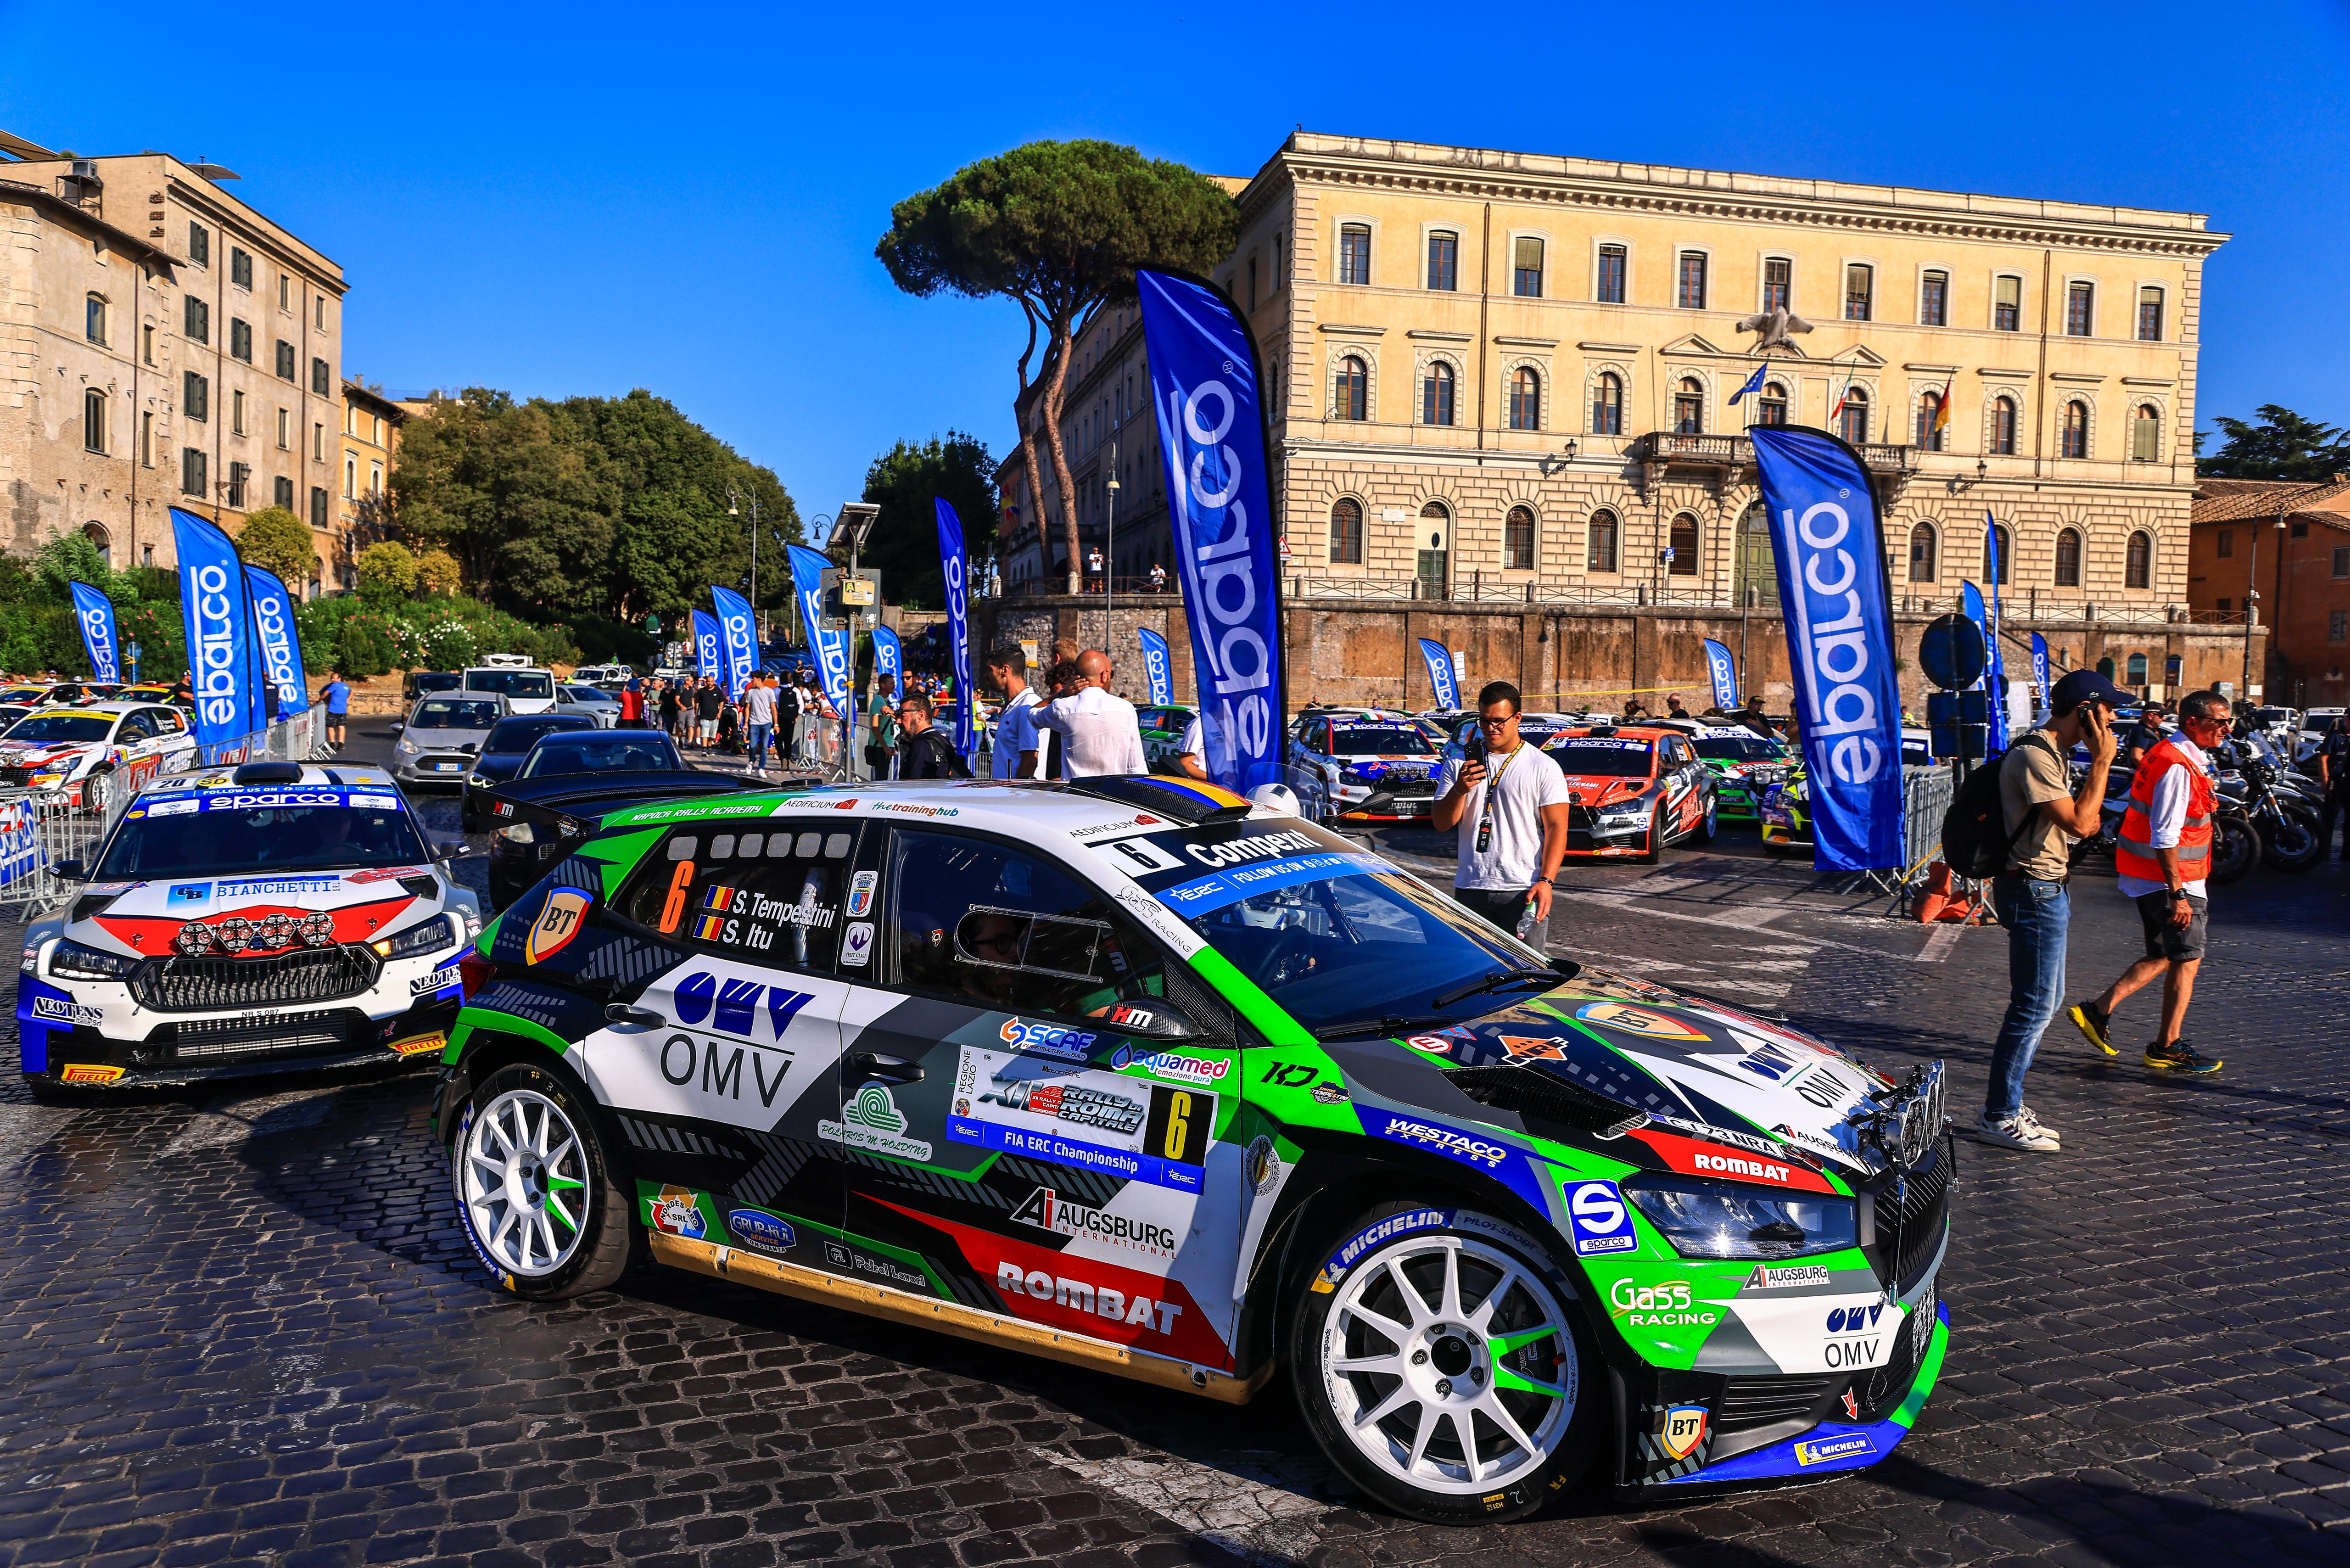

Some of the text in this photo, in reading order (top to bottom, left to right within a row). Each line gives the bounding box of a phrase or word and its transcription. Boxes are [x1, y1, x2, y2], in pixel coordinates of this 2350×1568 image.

[1568, 740, 1622, 749] sparco
[158, 778, 187, 789] 20
[209, 794, 340, 810] sparco
[630, 805, 763, 822] NAPOCA RALLY ACADEMY
[783, 798, 834, 810] AEDIFICIUM
[872, 801, 959, 817] thetraininghub
[1069, 820, 1138, 838] AEDIFICIUM
[1112, 843, 1160, 869] 6
[1185, 829, 1325, 868] Compexit
[1234, 862, 1303, 884] FOLLOW US ON
[216, 882, 333, 897] BIANCHETTI
[660, 861, 694, 934] 6
[543, 906, 577, 935] BT
[733, 890, 837, 929] S. Tempestini
[723, 919, 774, 950] S. Itu
[1153, 918, 1193, 954] RACING
[35, 997, 103, 1019] NEOTENS
[1607, 1010, 1658, 1029] BT
[75, 1017, 102, 1027] Italia Srl
[1109, 1021, 1147, 1030] KEANEMOTORSPORT
[395, 1035, 442, 1053] PIRELLI
[1022, 1043, 1064, 1055] INFRASTRUCTURE
[1024, 1028, 1097, 1052] SCAF
[67, 1068, 118, 1081] PIRELLI
[660, 1033, 793, 1109] OMV
[958, 1049, 971, 1092] REGIONE
[1132, 1049, 1230, 1079] aquamed
[1158, 1069, 1210, 1084] emozione pura
[966, 1065, 977, 1094] LAZIO
[1795, 1068, 1852, 1109] OMV
[1063, 1086, 1131, 1107] RALLY
[1058, 1110, 1137, 1132] CAPITALE
[1059, 1098, 1144, 1124] ROMA
[1164, 1091, 1192, 1160] 6
[820, 1123, 865, 1142] POLARIS
[880, 1137, 929, 1159] HOLDING
[1385, 1129, 1497, 1168] EXPRESS
[1389, 1118, 1507, 1160] WESTACO
[1707, 1127, 1730, 1140] 73
[1733, 1132, 1776, 1153] NRA
[1005, 1131, 1139, 1175] FIA ERC Championship
[1695, 1153, 1790, 1183] ROMBAT
[660, 1200, 698, 1226] NORDES PRO
[672, 1213, 688, 1223] SRL
[1571, 1183, 1625, 1234] S
[457, 1206, 498, 1274] MICHELIN
[750, 1233, 779, 1245] SERVICE
[1055, 1203, 1175, 1251] AUGSBURG
[1341, 1211, 1446, 1263] MICHELIN
[1463, 1216, 1539, 1251] PILOT SPORT
[1055, 1223, 1177, 1260] INTERNATIONAL
[1586, 1236, 1627, 1250] sparco
[854, 1254, 926, 1287] Petrol Lavori
[1767, 1266, 1829, 1282] AUGSBURG
[1768, 1278, 1830, 1287] INTERNATIONAL
[997, 1261, 1183, 1336] ROMBAT
[1611, 1277, 1692, 1312] Gass
[1629, 1310, 1717, 1326] RACING
[1323, 1328, 1332, 1359] speedline
[1824, 1338, 1880, 1368] OMV
[1671, 1418, 1699, 1437] BT
[1821, 1439, 1868, 1455] MICHELIN
